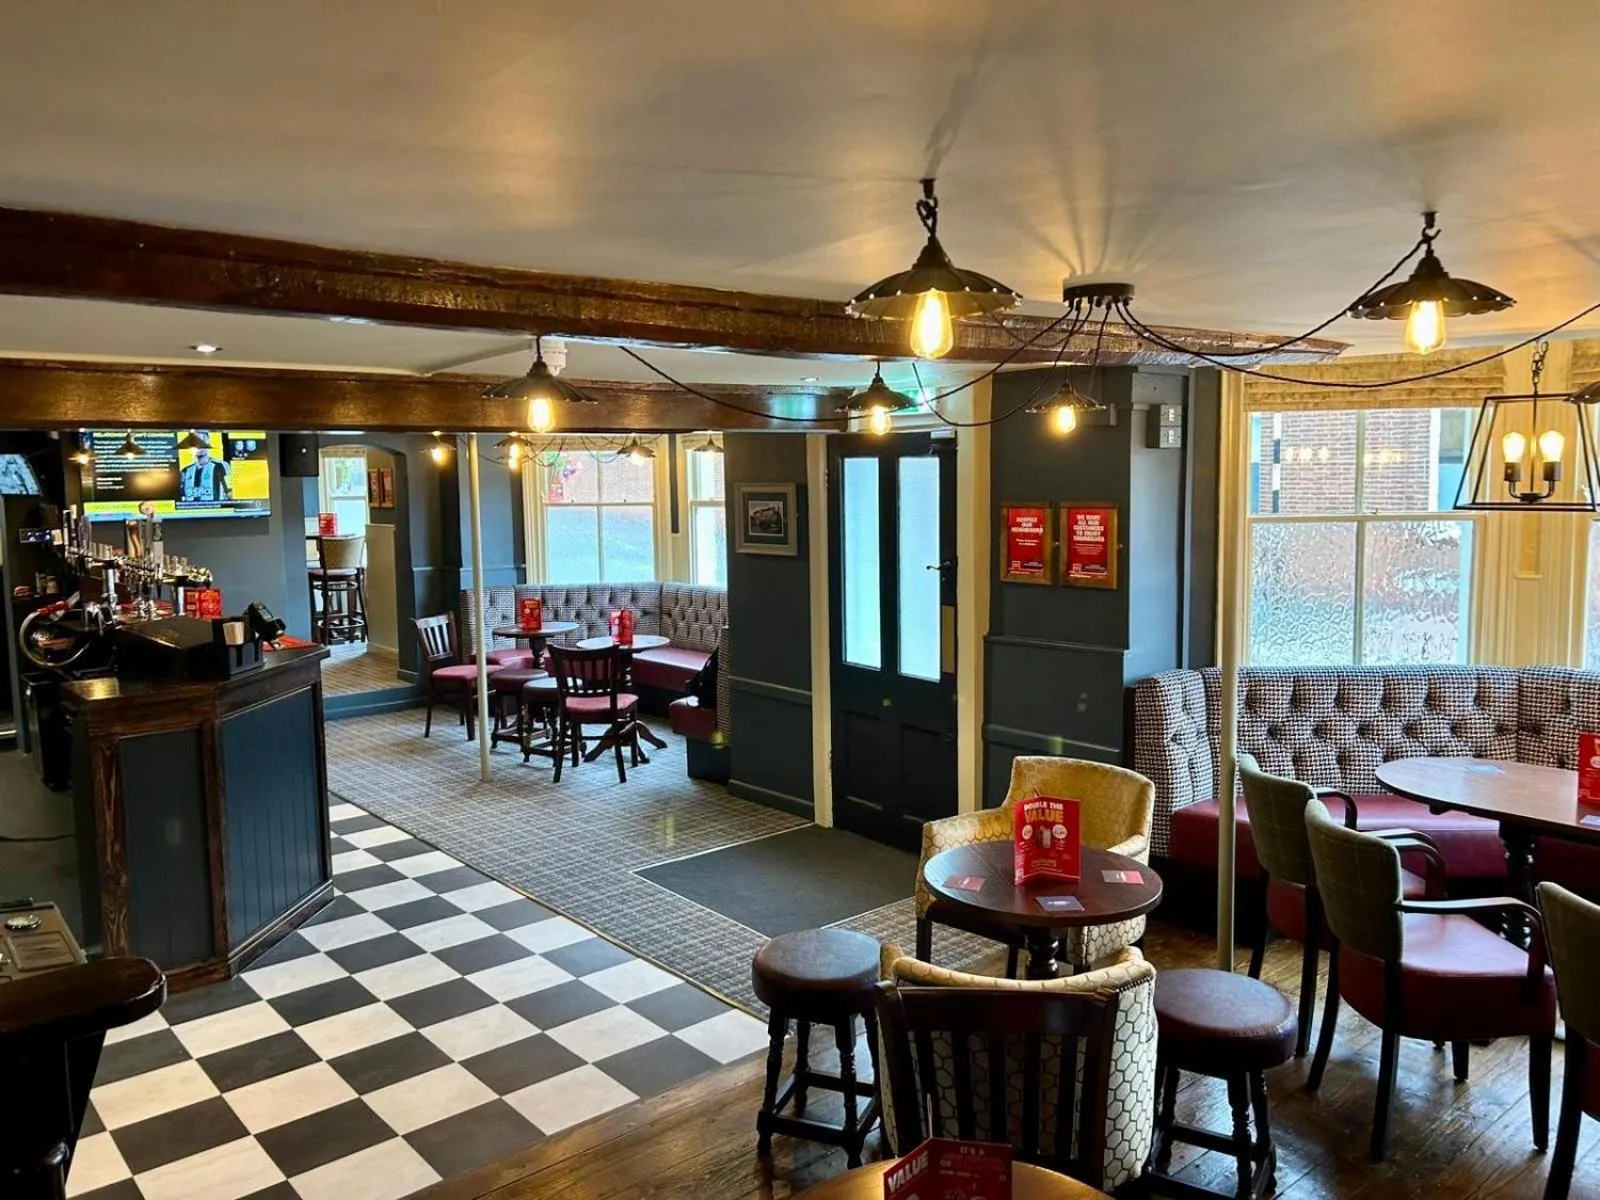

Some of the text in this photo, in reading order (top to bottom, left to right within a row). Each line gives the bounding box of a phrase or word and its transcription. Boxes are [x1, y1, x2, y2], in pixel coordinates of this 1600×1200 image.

[1023, 801, 1064, 811] DOUBLE THE
[1024, 808, 1065, 823] VALUE
[887, 1150, 929, 1194] VALUE
